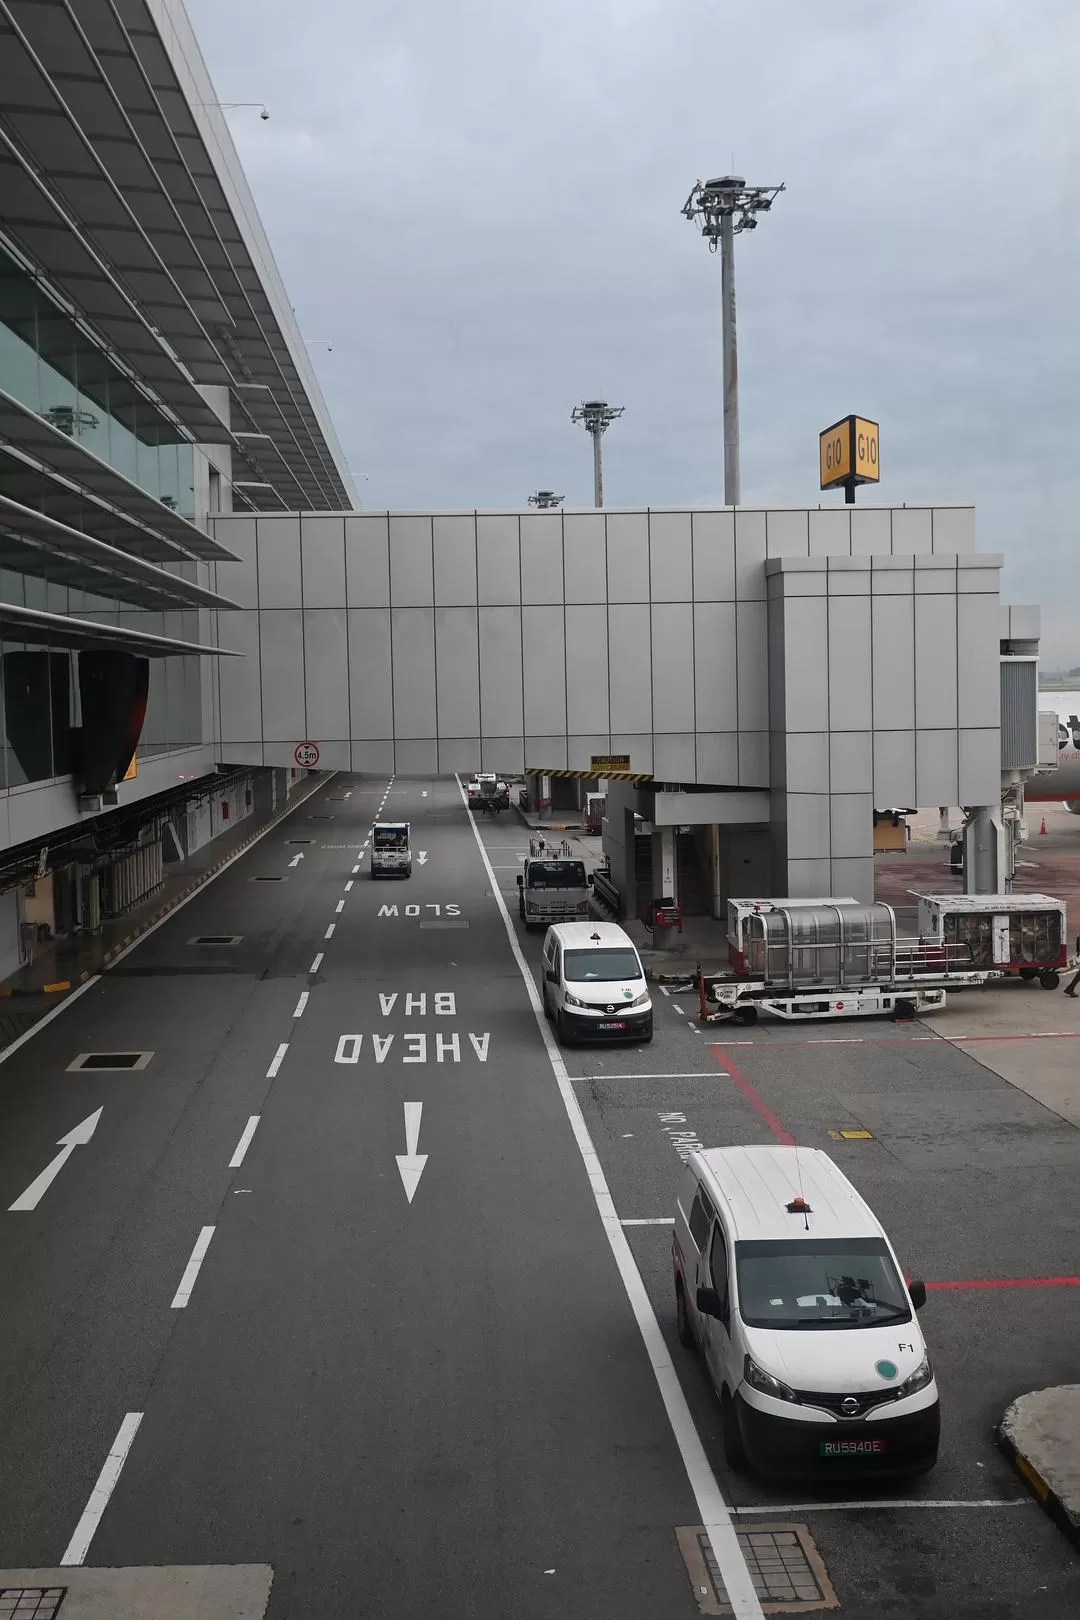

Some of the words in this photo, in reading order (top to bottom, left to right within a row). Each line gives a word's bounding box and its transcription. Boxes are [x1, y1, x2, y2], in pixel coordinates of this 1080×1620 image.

[826, 438, 842, 470] G10
[858, 434, 877, 465] G10
[297, 751, 317, 760] 4.5m
[377, 904, 461, 917] SLOW
[378, 992, 457, 1016] BHA
[334, 1032, 491, 1064] AHEAD
[657, 1112, 687, 1123] NO
[898, 1343, 914, 1353] F1
[825, 1441, 881, 1454] RU5940E
